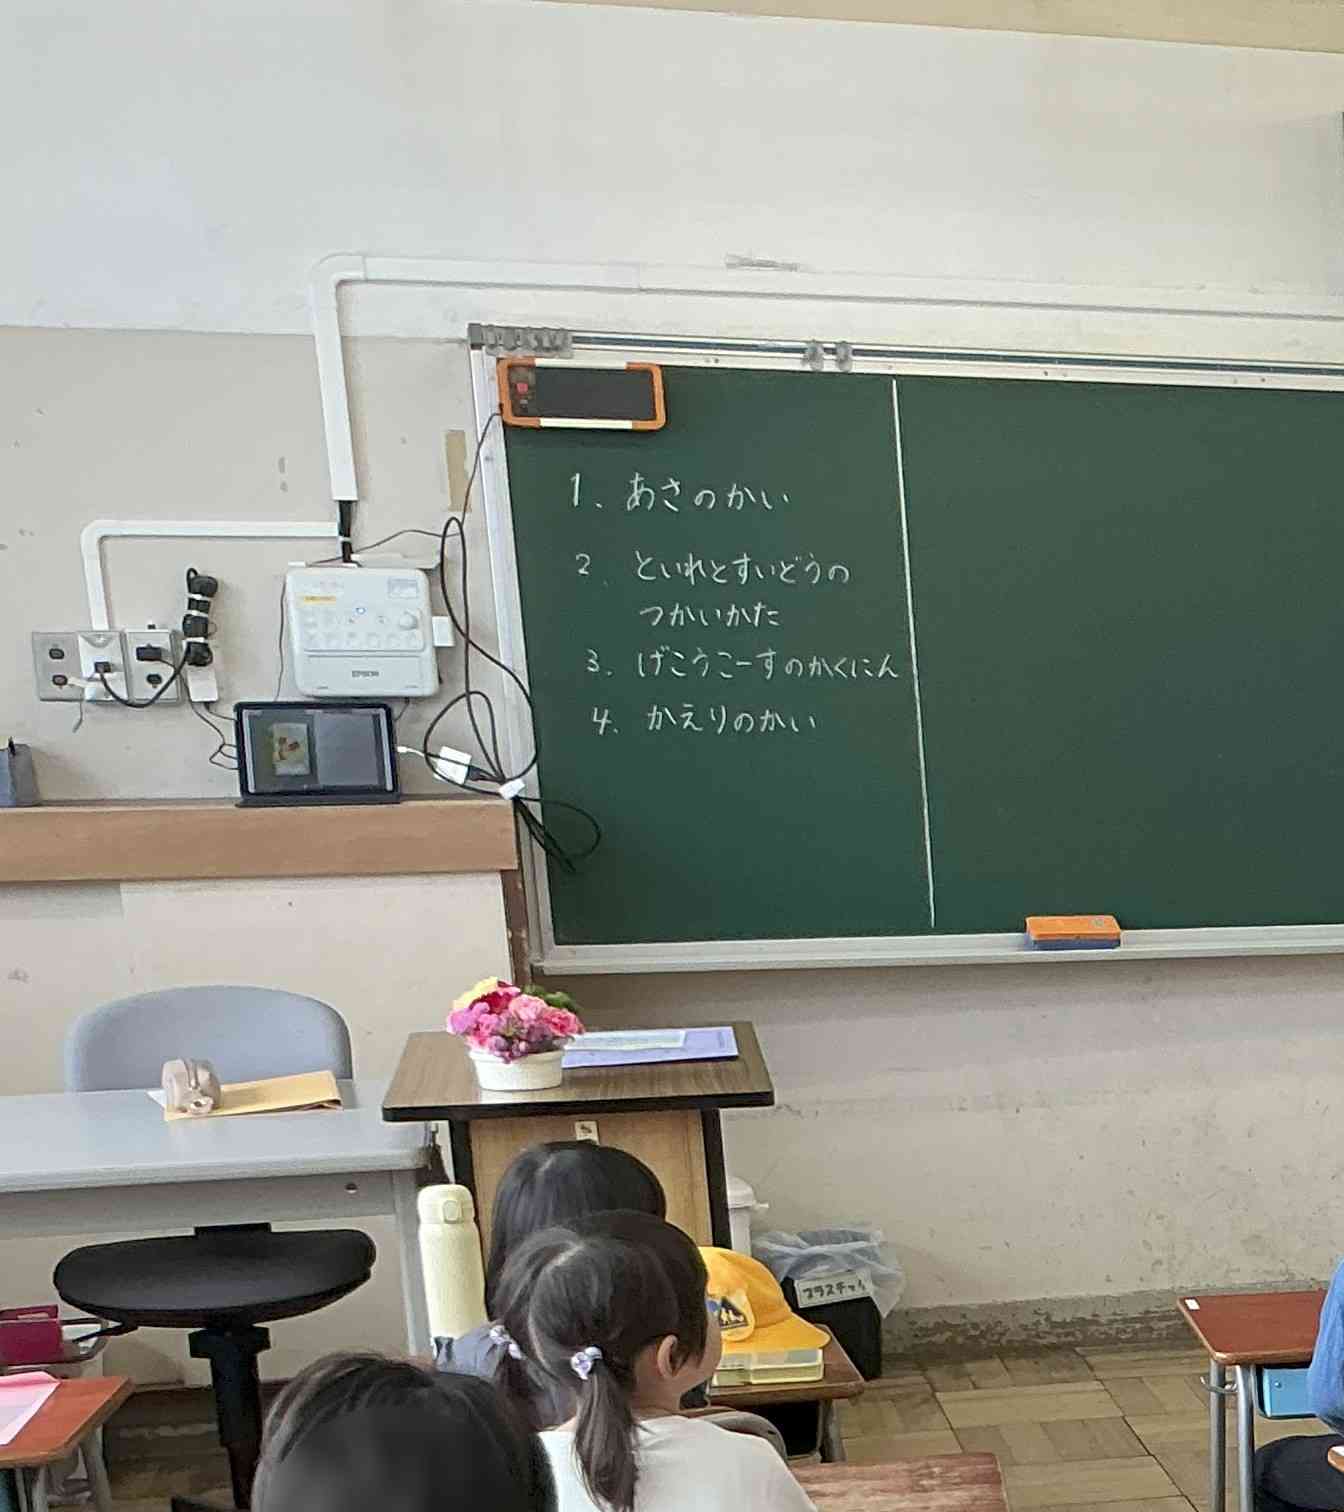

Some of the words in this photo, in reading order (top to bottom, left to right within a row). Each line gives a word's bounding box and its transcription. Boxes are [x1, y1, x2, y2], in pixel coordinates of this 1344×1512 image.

[639, 601, 782, 629] つかいかた
